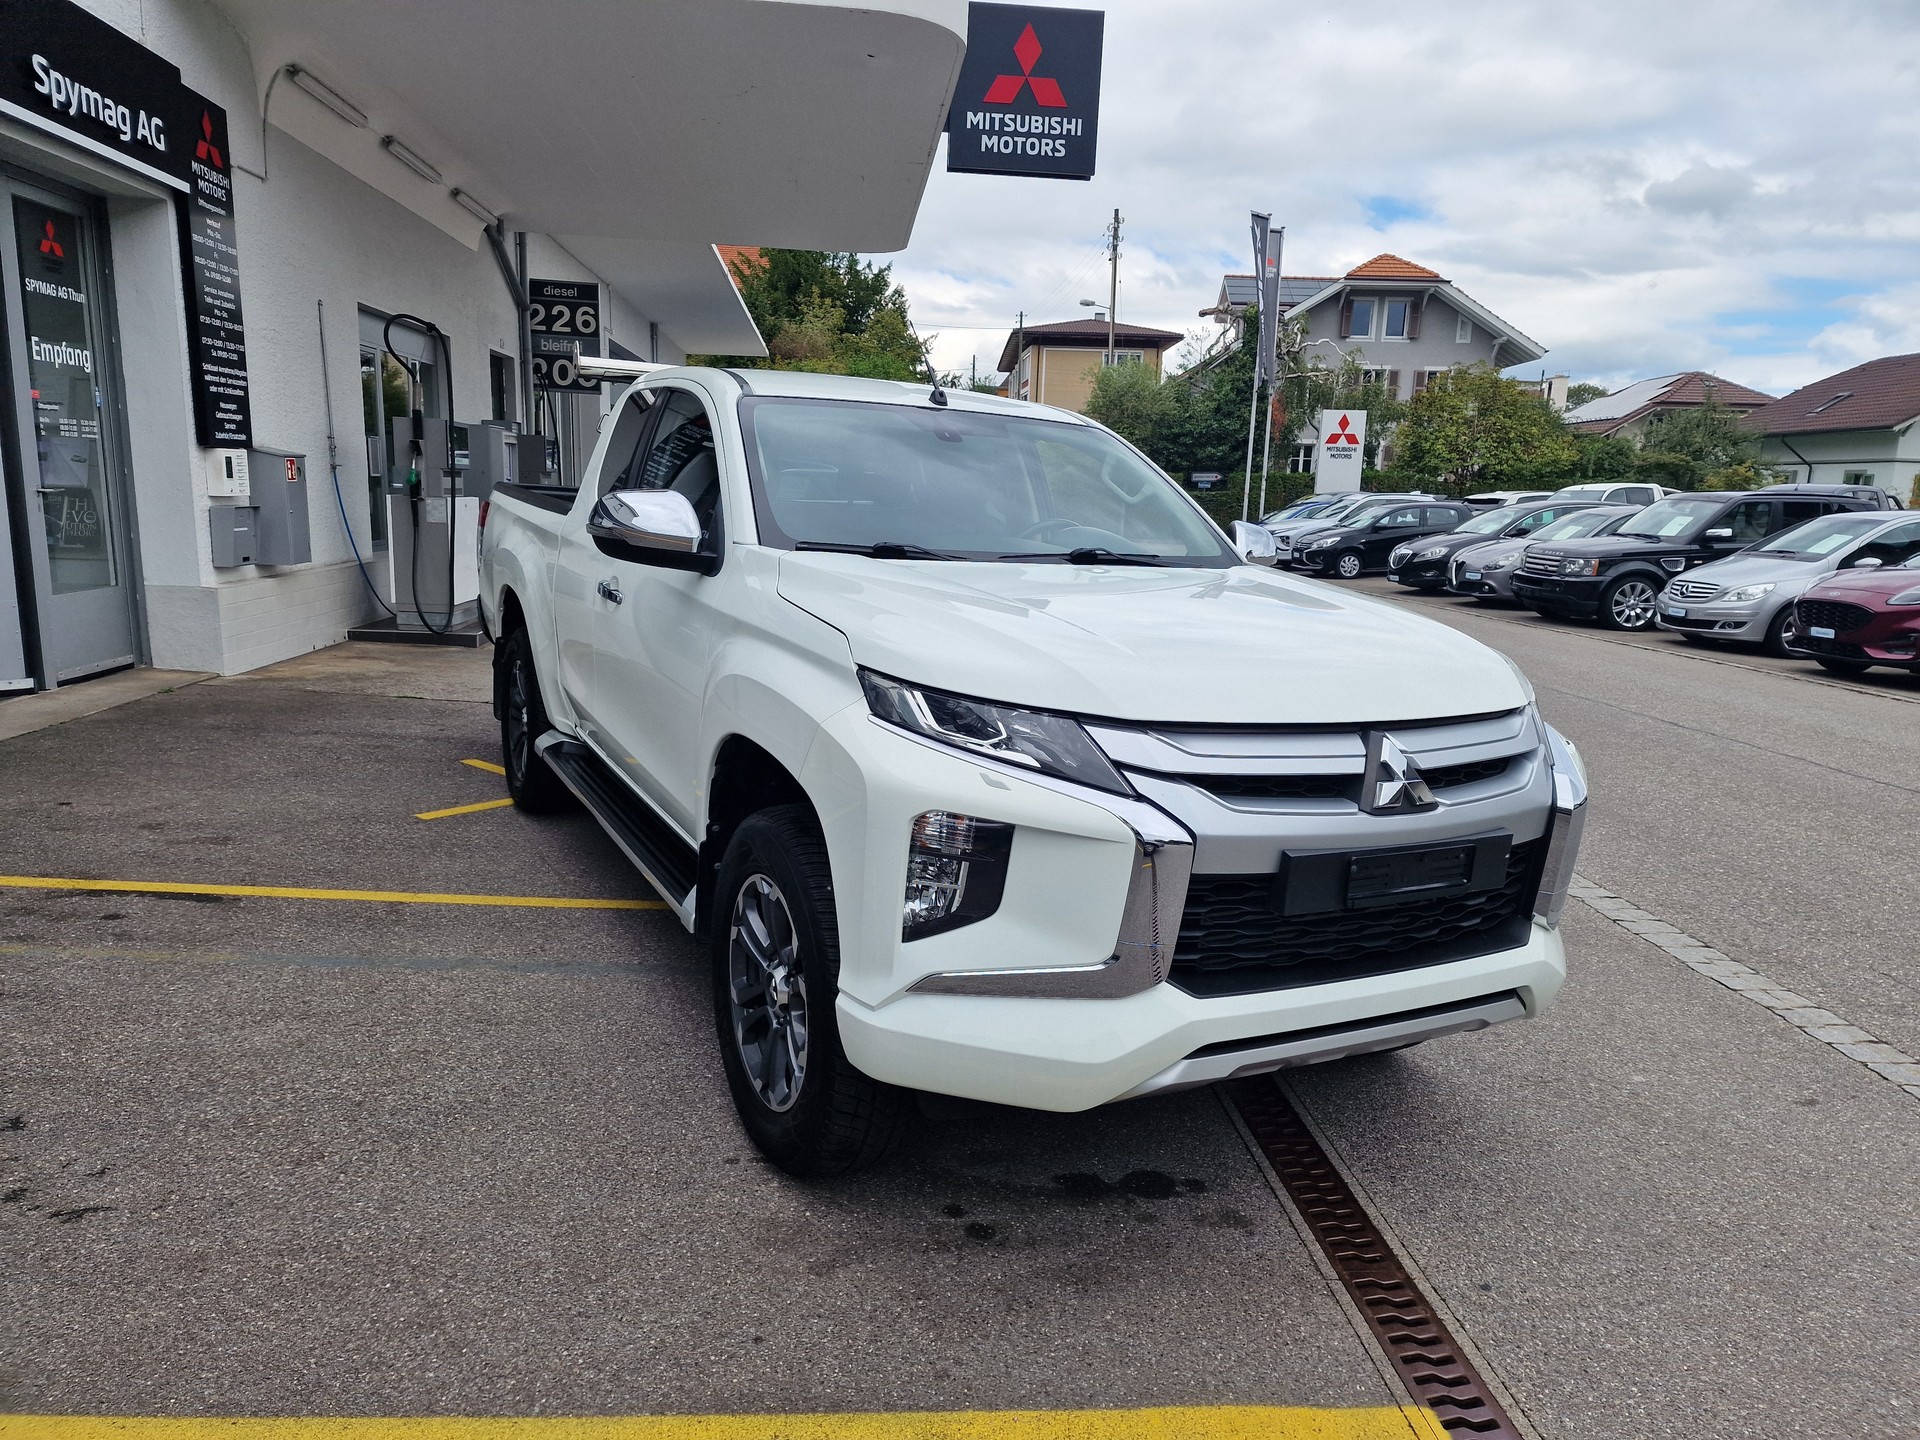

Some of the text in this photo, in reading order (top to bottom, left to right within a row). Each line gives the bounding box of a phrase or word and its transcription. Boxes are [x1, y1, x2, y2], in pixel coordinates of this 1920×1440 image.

[31, 53, 166, 151] Spymag AG
[966, 111, 1083, 136] MITSUBISHI
[980, 134, 1066, 157] MOTORS
[191, 160, 231, 190] MITSUBISHI
[198, 178, 226, 202] MOTORS
[25, 277, 86, 304] SPYMAG AG Thun
[543, 285, 578, 297] diesel
[530, 303, 597, 334] 226
[31, 335, 91, 373] Empfang
